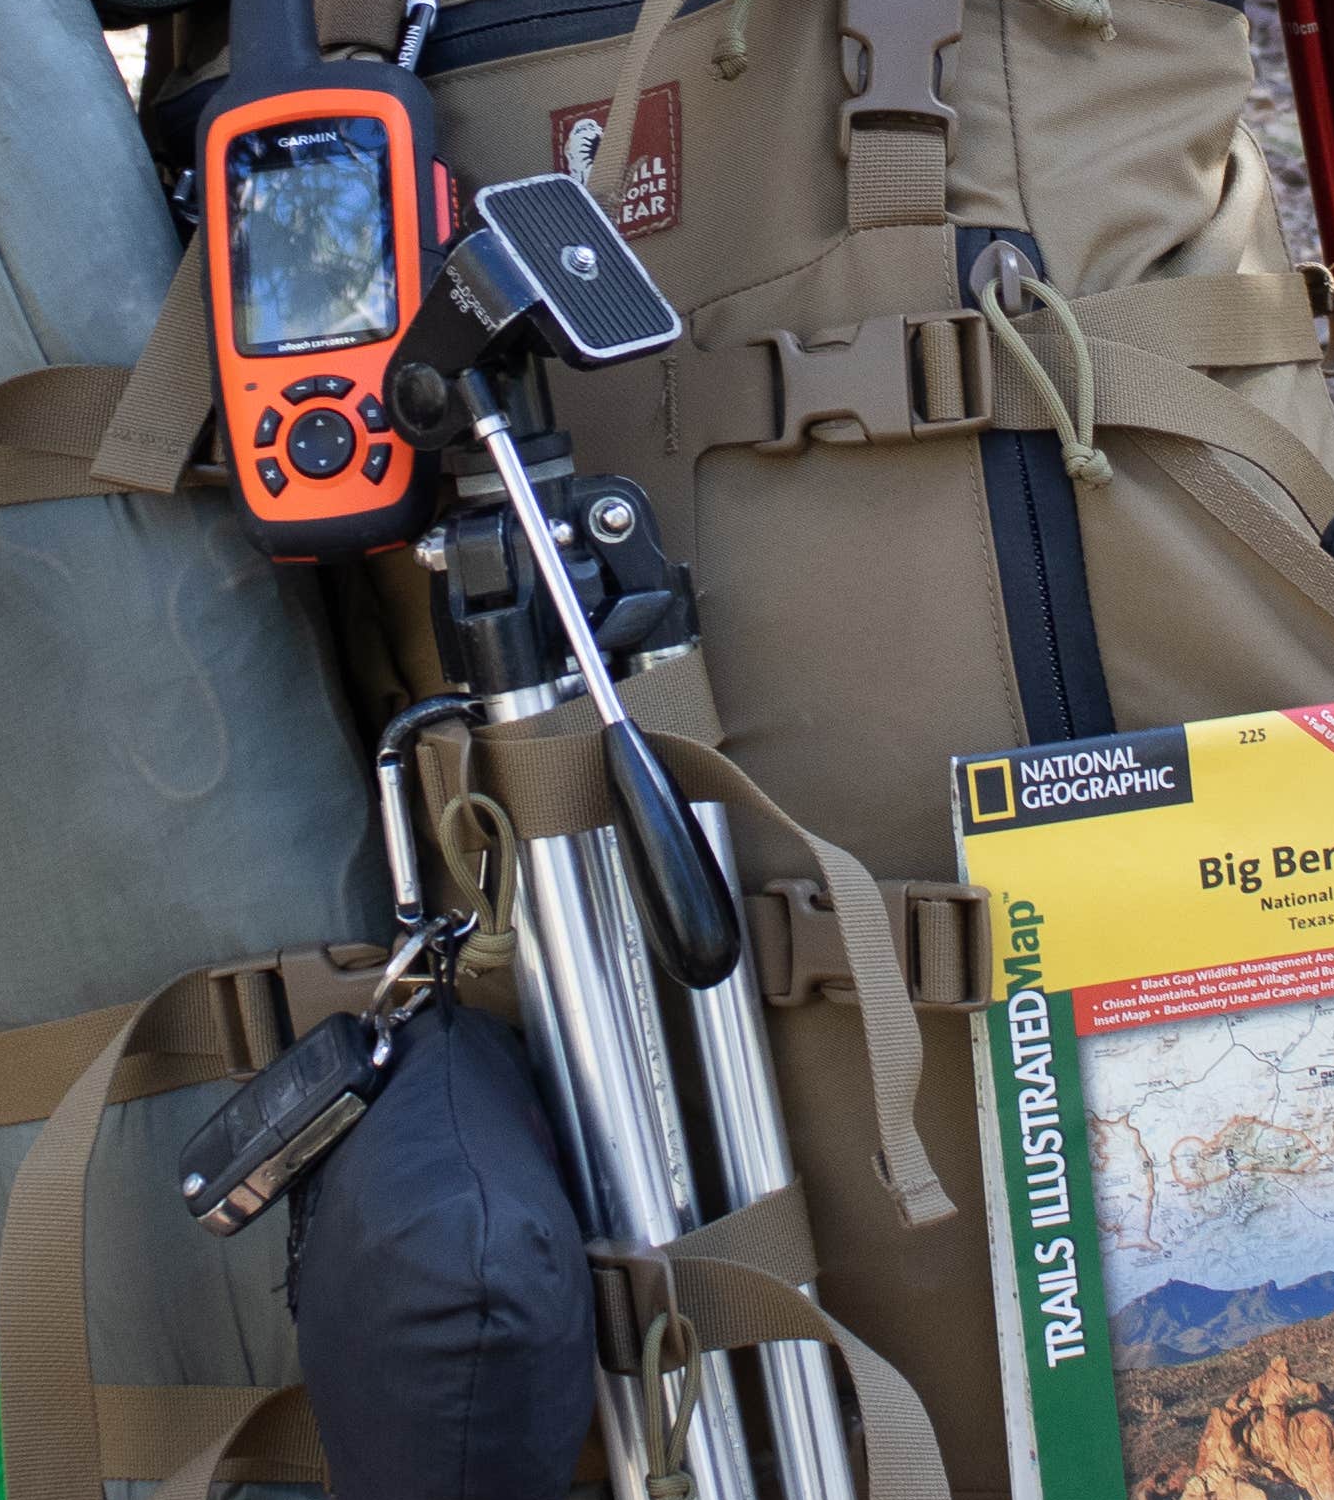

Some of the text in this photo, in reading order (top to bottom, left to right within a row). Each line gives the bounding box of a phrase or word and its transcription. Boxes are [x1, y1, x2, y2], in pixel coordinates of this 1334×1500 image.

[397, 25, 421, 68] ARMIN
[278, 131, 337, 148] GARMIN
[618, 196, 666, 224] EAR
[624, 178, 666, 202] OPLE
[446, 265, 498, 332] GOLDCREST
[1239, 728, 1267, 745] 225
[1020, 746, 1142, 784] NATIONAL
[1021, 766, 1176, 809] GEOGRAPHIC
[1199, 852, 1263, 894] Big
[1260, 886, 1334, 911] National
[1102, 997, 1138, 1011] Chisos
[1138, 987, 1199, 1006] Mountains,
[1199, 983, 1218, 996] Rio
[1218, 976, 1258, 993] Grande
[1258, 972, 1299, 987] Village,
[1299, 966, 1320, 979] and
[1141, 977, 1171, 990] Black
[1172, 975, 1195, 986] Gap
[1195, 965, 1239, 982] Wildlife
[1239, 954, 1313, 974] Management
[1094, 1013, 1121, 1026] Inset
[1122, 1009, 1151, 1022] Maps
[1163, 998, 1228, 1016] Backcountry
[1229, 992, 1251, 1005] Use
[1250, 989, 1272, 1001] and
[1272, 983, 1320, 998] Camping
[1003, 901, 1085, 1368] TRAILS ILLUSTRATED Map
